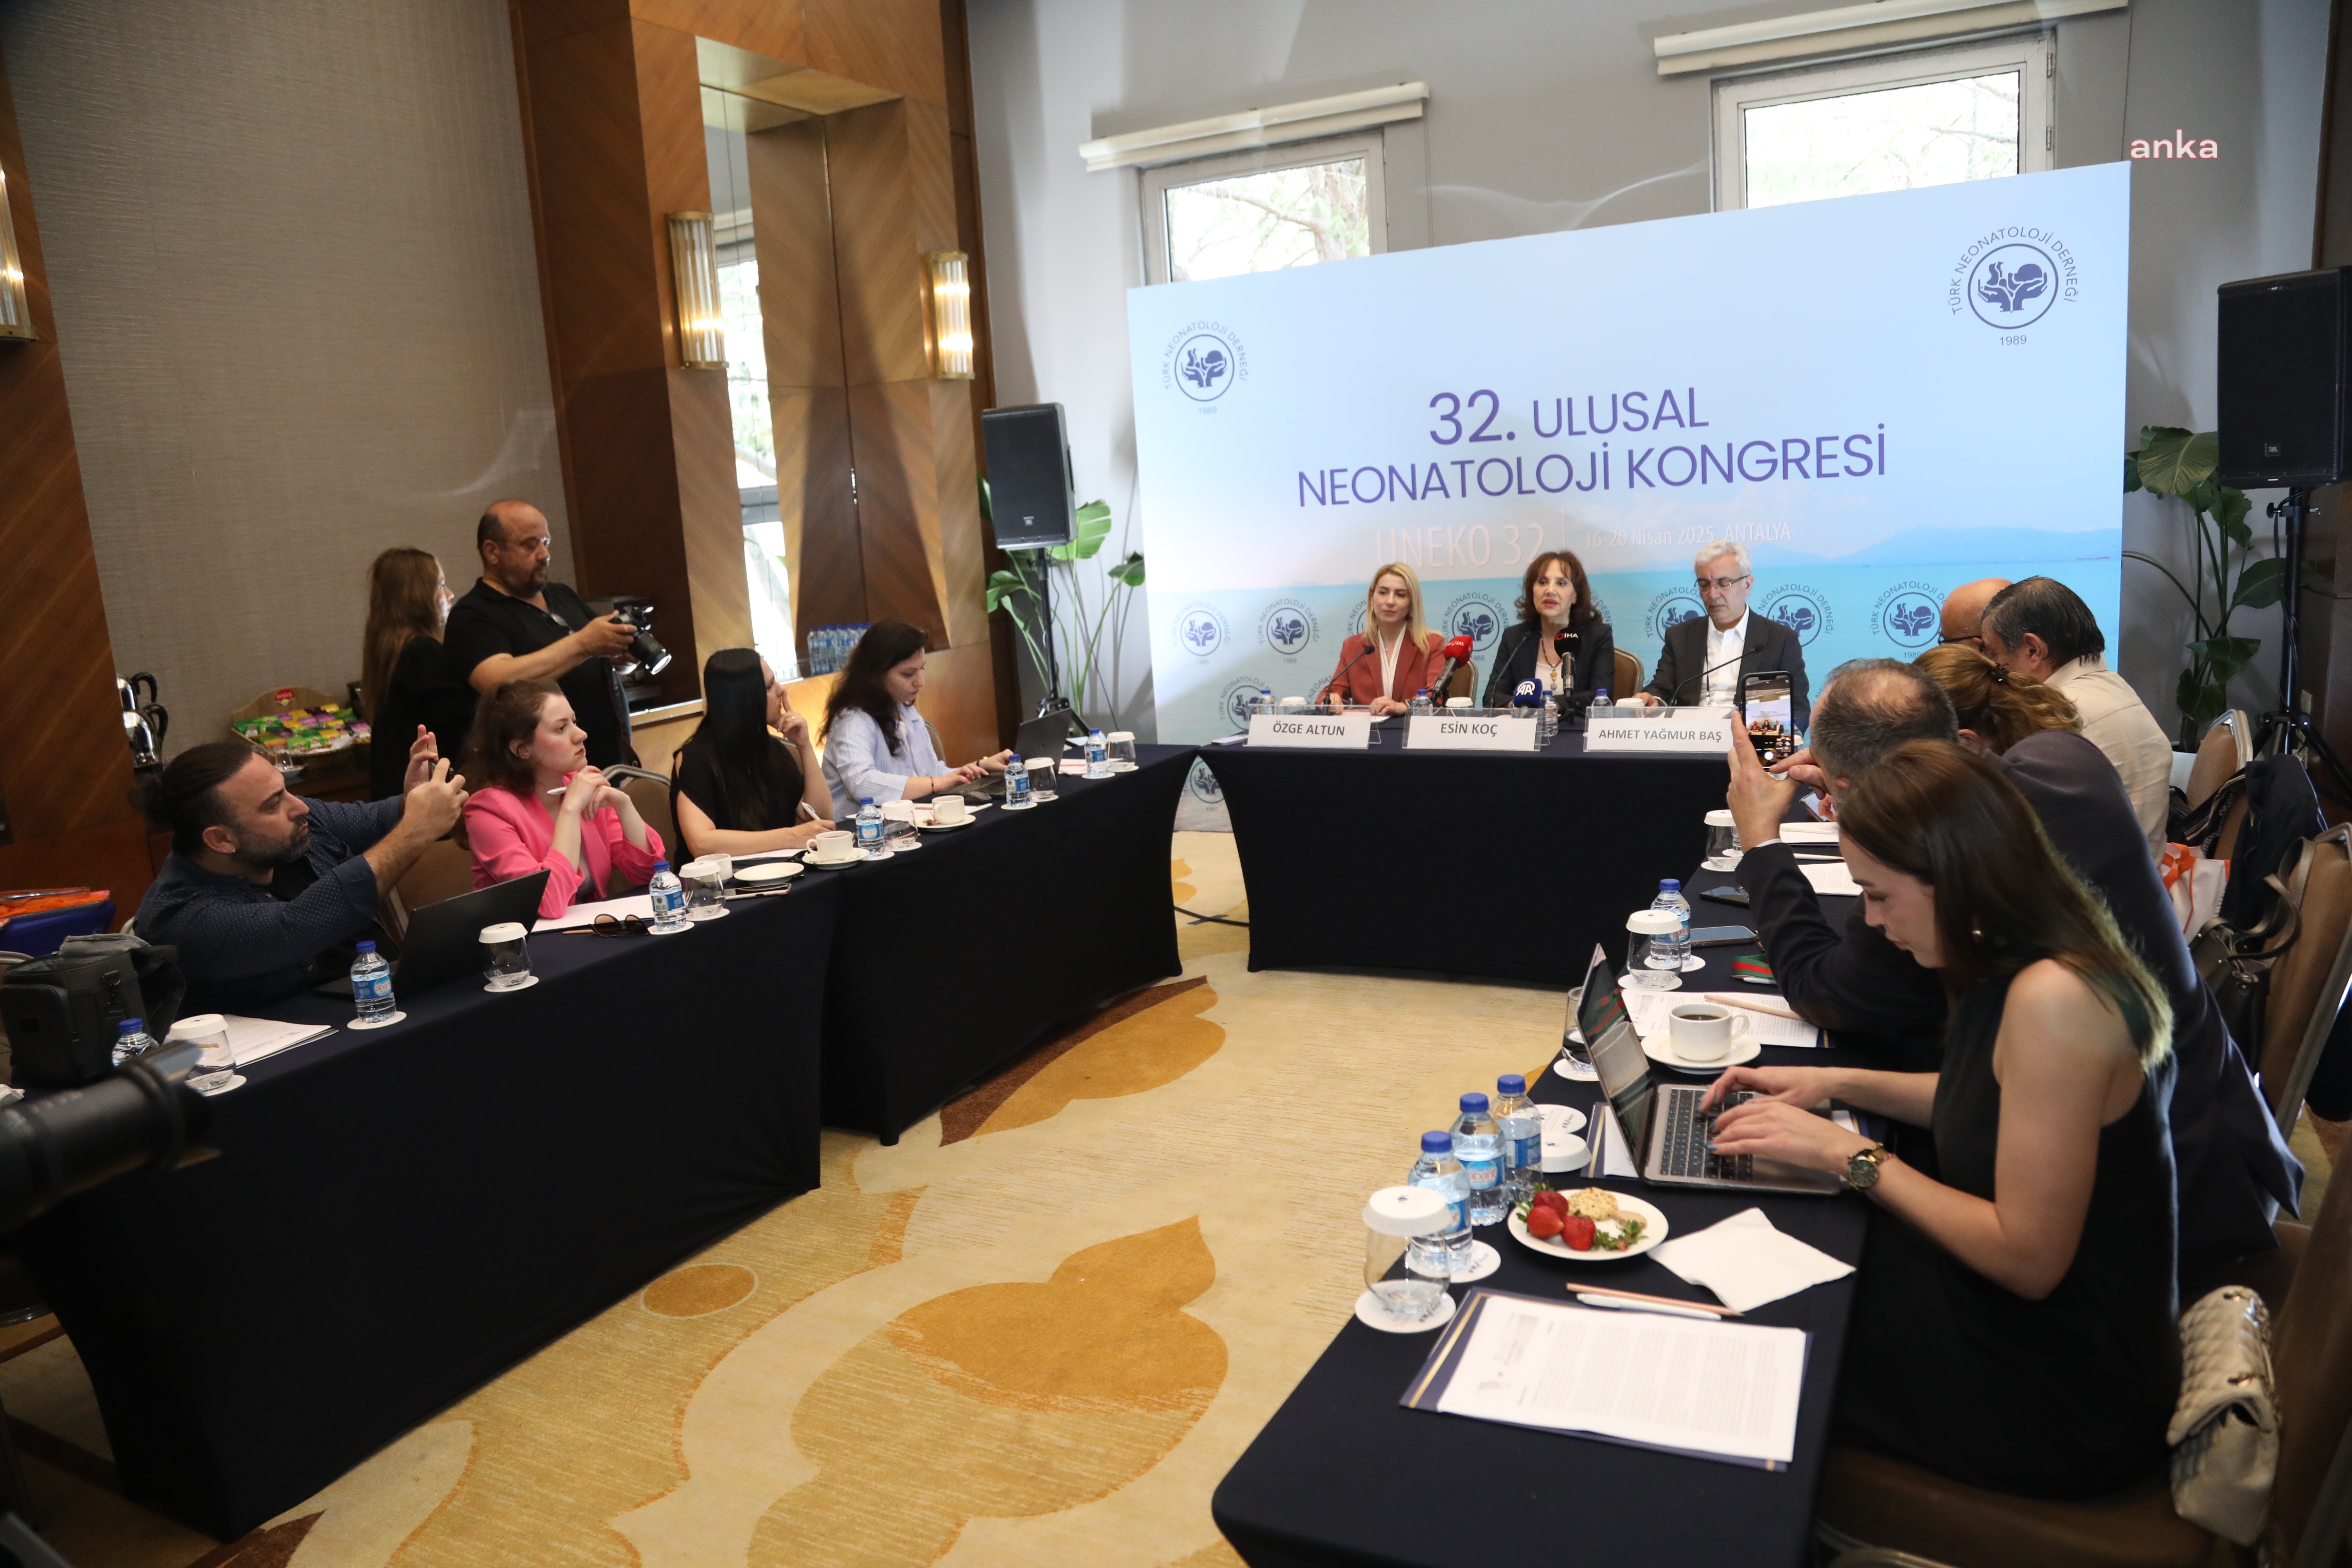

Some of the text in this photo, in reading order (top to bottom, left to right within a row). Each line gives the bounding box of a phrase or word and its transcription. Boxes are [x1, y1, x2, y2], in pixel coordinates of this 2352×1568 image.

[1948, 227, 2079, 315] TÜRK NEONATOLOJİ DERNEĞİ
[2000, 335, 2027, 346] 1989
[1162, 320, 1249, 390] TÜRK NEONATOLOJİ DERNEĞİ
[1199, 406, 1217, 415] 1989
[1429, 387, 1709, 445] 32. ULUSAL
[1298, 423, 1885, 507] NEONATOLOJİ KONGRESİ
[1376, 523, 1545, 569] UNEKO 32
[1586, 530, 1628, 548] 16-20
[1632, 528, 1672, 546] Nisan
[1724, 522, 1791, 543] ANTALYA
[1495, 602, 1510, 629] DERNE
[1758, 583, 1834, 635] NEONATOLOJİ DERNEĞİ
[1870, 611, 1880, 635] TÜRK
[1875, 581, 1939, 609] NEONATOLOJİ
[1644, 615, 1654, 638] TÜRK
[1273, 721, 1345, 736] ÖZGE ALTUN
[1440, 721, 1498, 737] ESİN KOÇ
[1599, 728, 1722, 742] AHMET YAĞMUR BAŞ
[1469, 1169, 1497, 1180] abant
